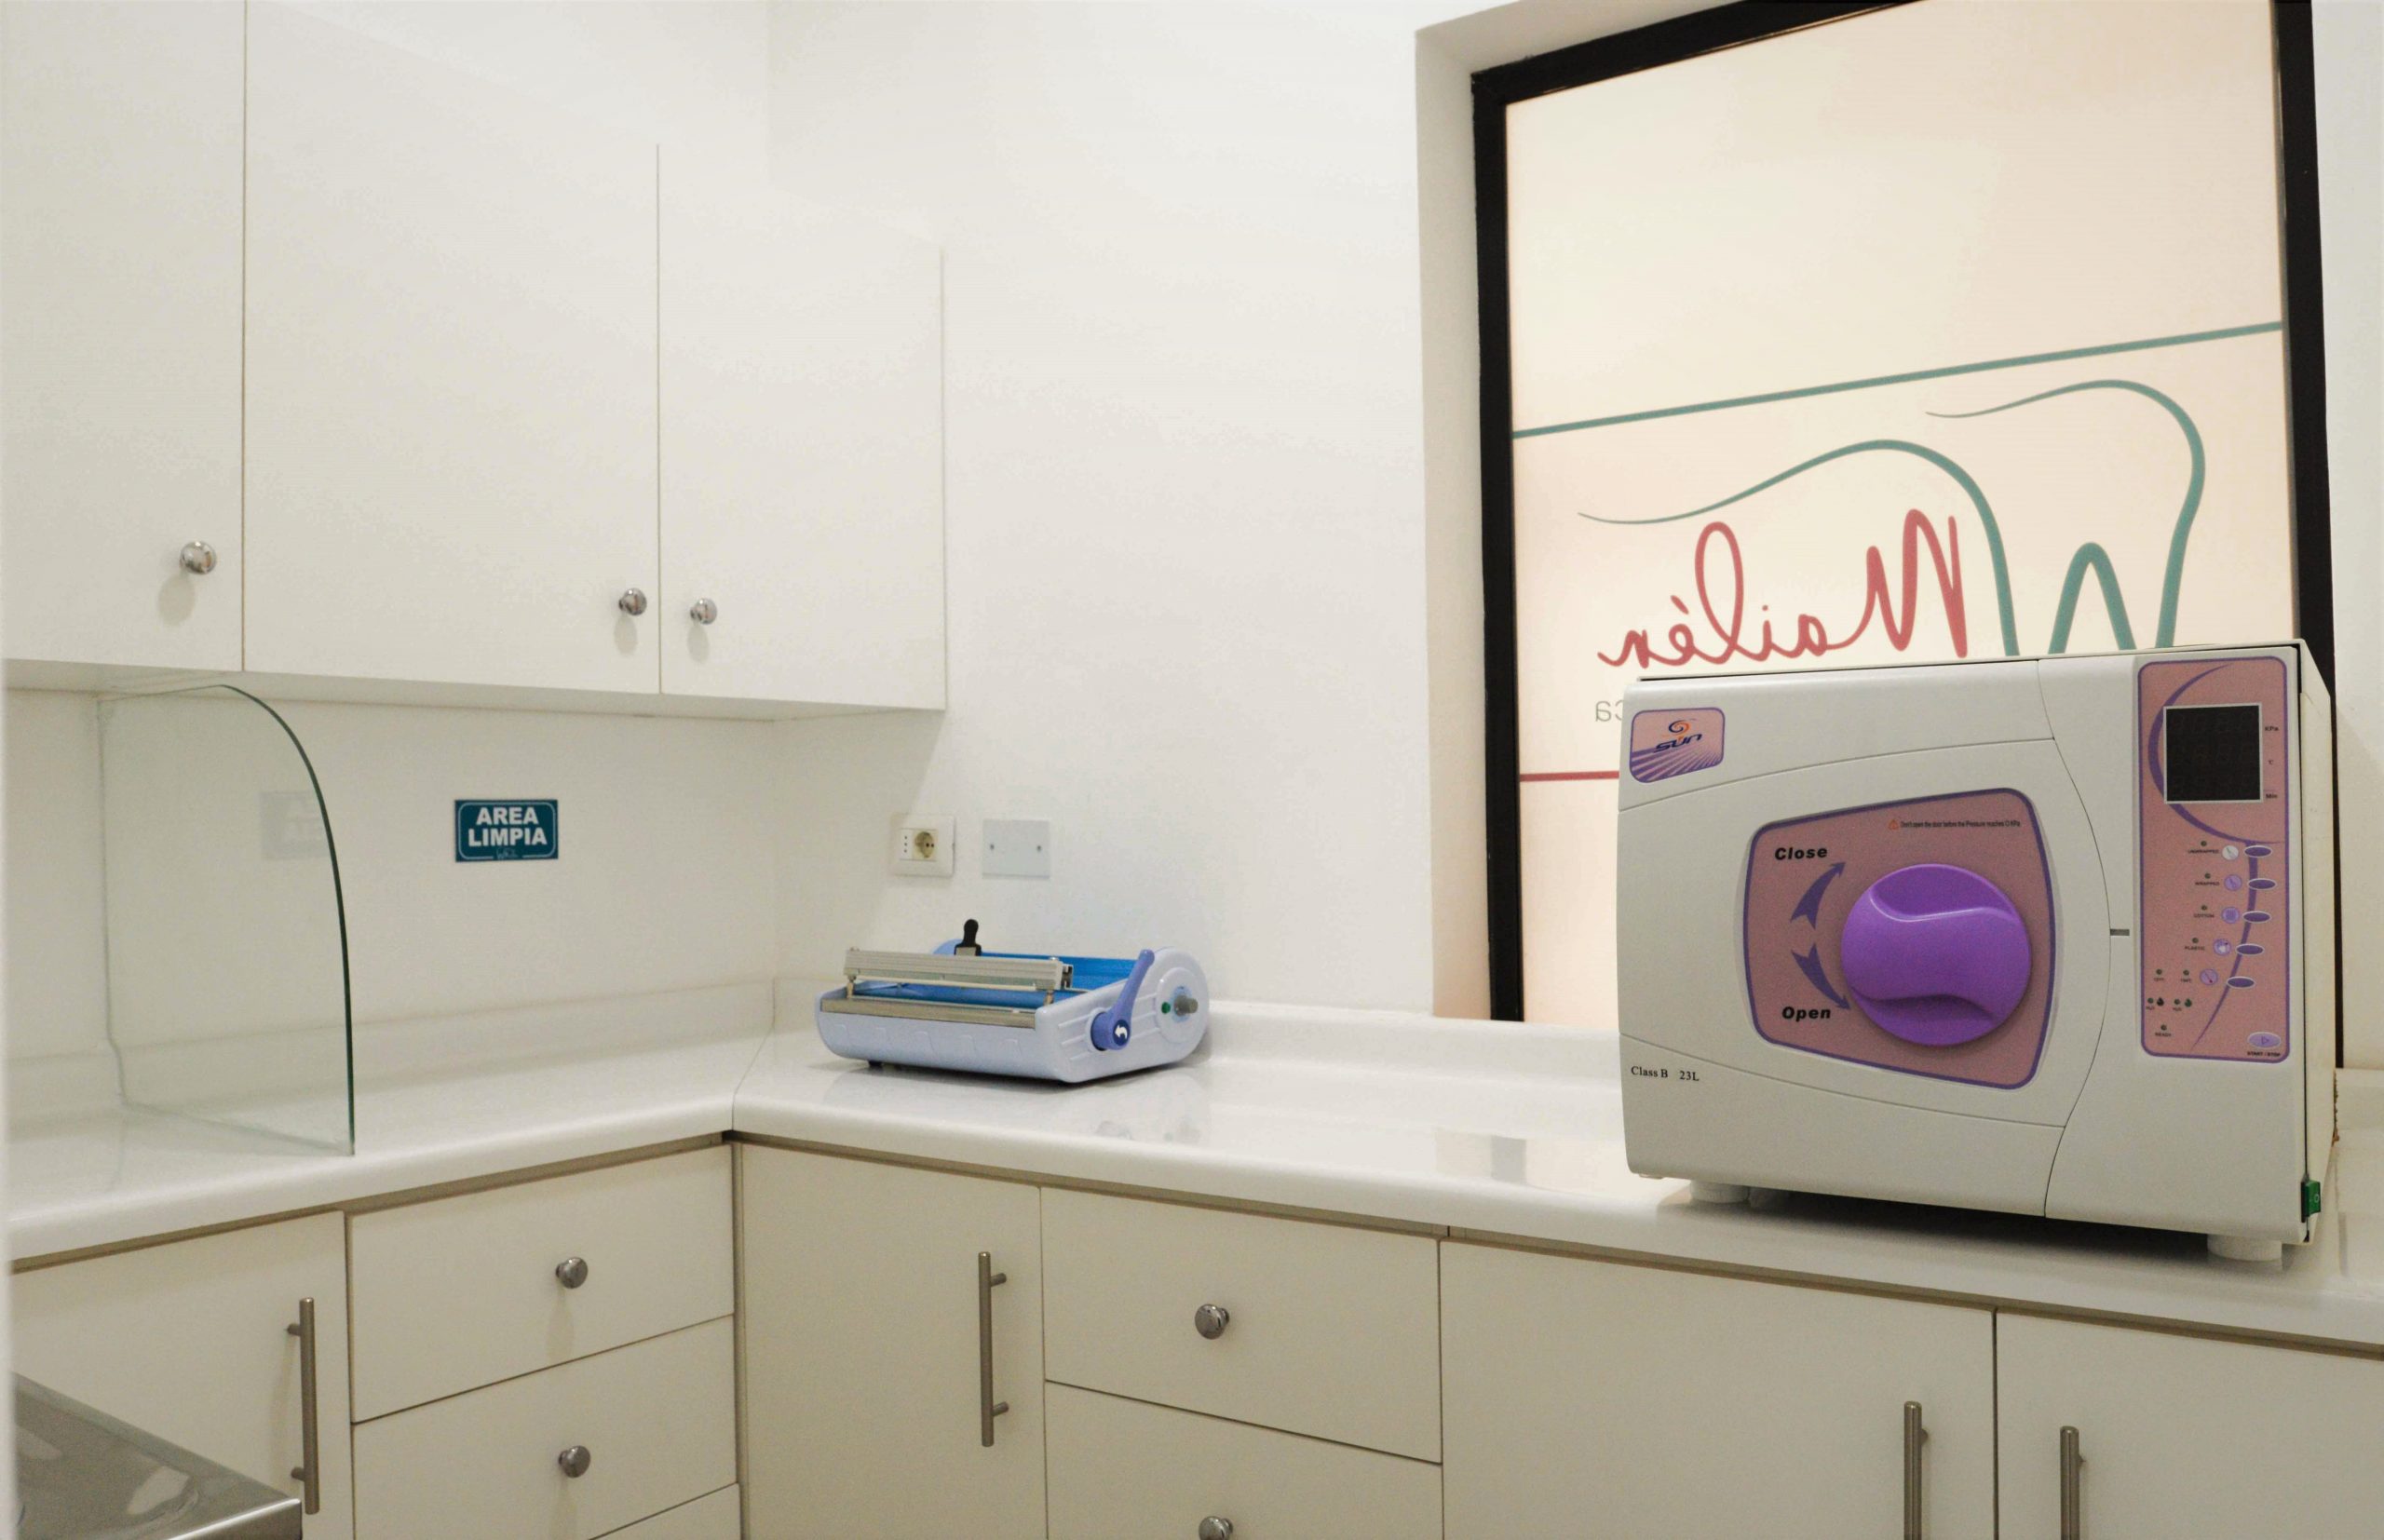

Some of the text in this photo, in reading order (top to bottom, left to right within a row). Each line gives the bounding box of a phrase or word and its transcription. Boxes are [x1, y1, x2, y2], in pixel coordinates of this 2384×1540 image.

[476, 806, 539, 826] AREA
[468, 826, 548, 847] LIMPIA
[1775, 847, 1827, 860] Close
[1781, 1006, 1831, 1022] Open
[1631, 1065, 1700, 1082] Class B 23L
